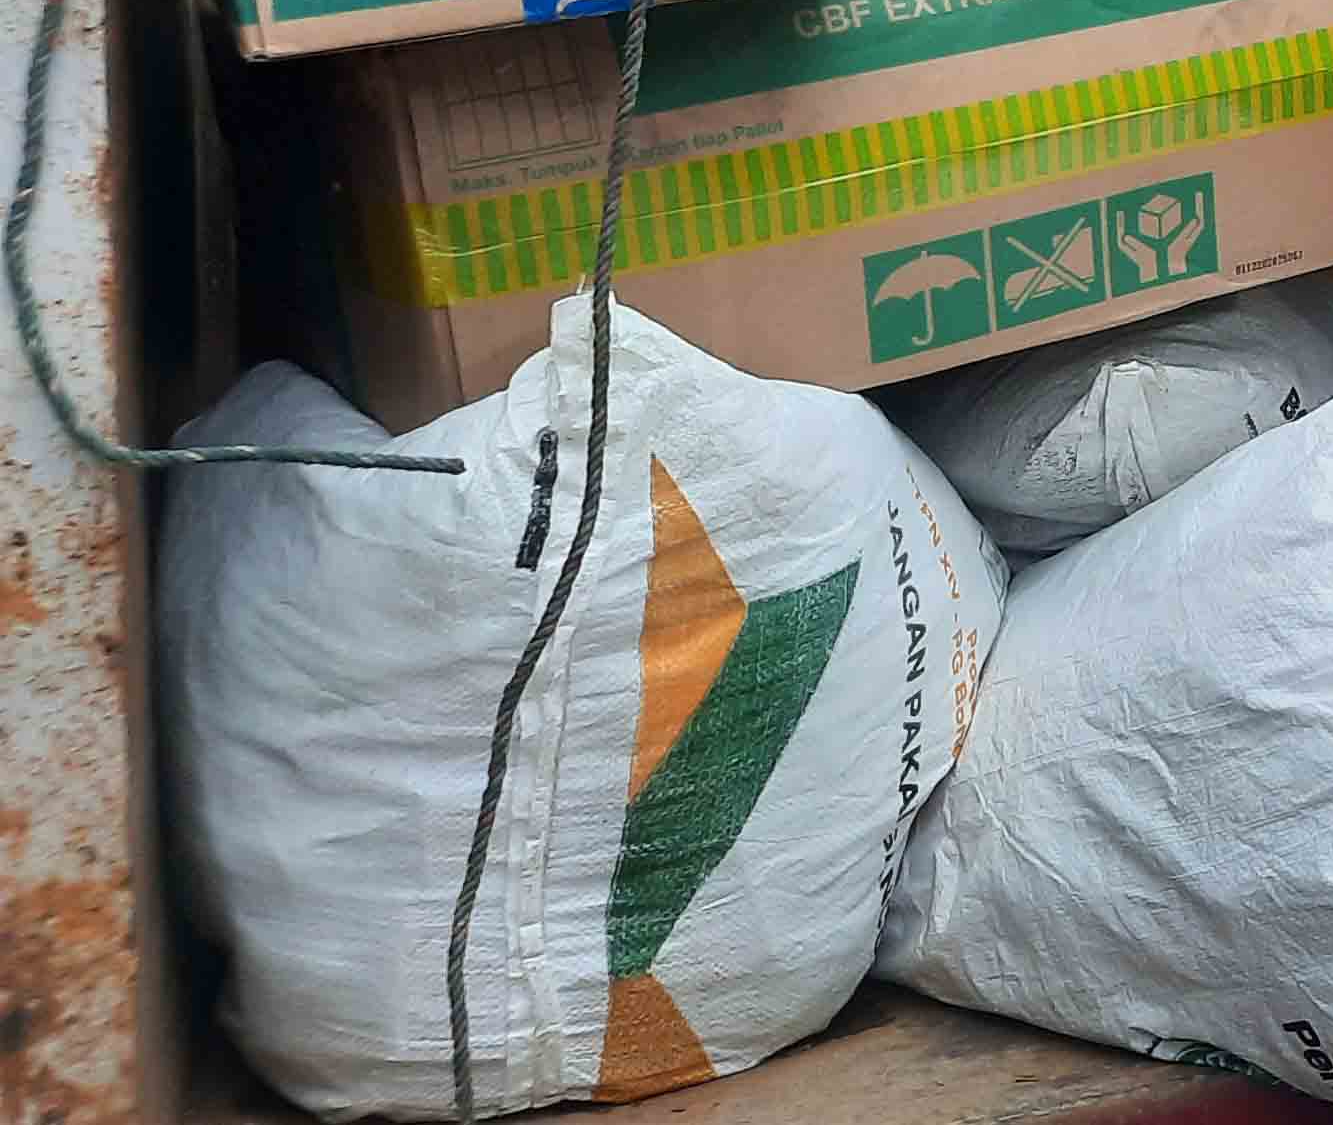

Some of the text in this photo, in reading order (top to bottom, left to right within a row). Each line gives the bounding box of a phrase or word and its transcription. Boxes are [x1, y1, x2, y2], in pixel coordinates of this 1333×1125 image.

[794, 0, 872, 40] CBF
[887, 499, 927, 684] JANGAN
[950, 628, 965, 675] PG
